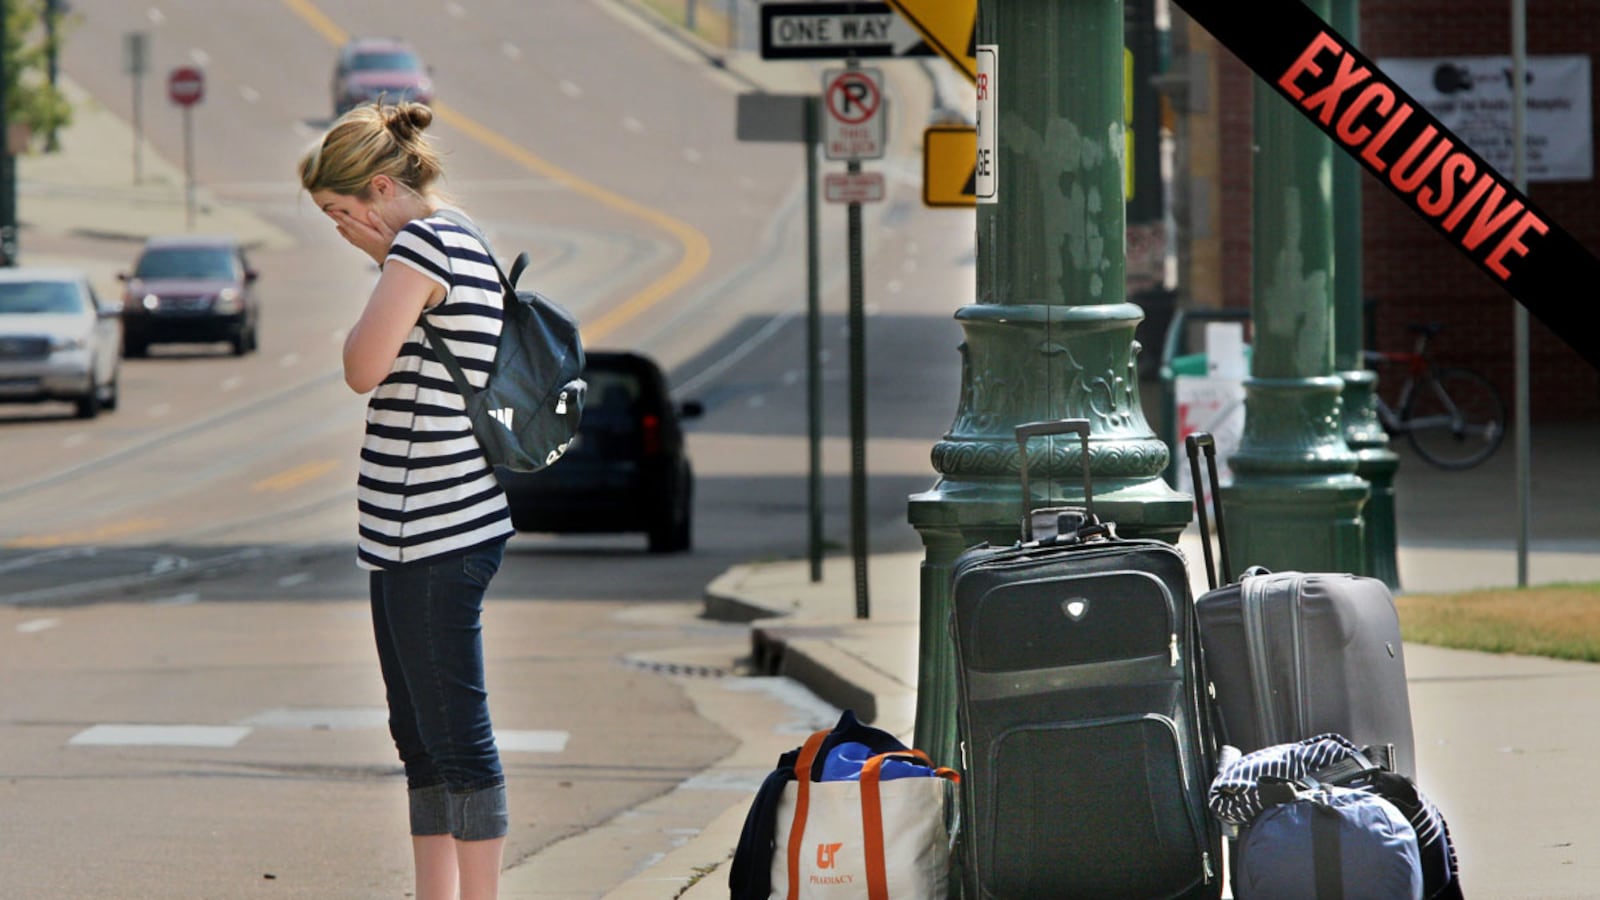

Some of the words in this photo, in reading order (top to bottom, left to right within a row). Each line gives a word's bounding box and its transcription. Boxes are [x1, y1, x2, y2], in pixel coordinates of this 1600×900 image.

[778, 18, 830, 42] ONE
[841, 17, 892, 41] WAY
[809, 874, 854, 886] PHARMACY
